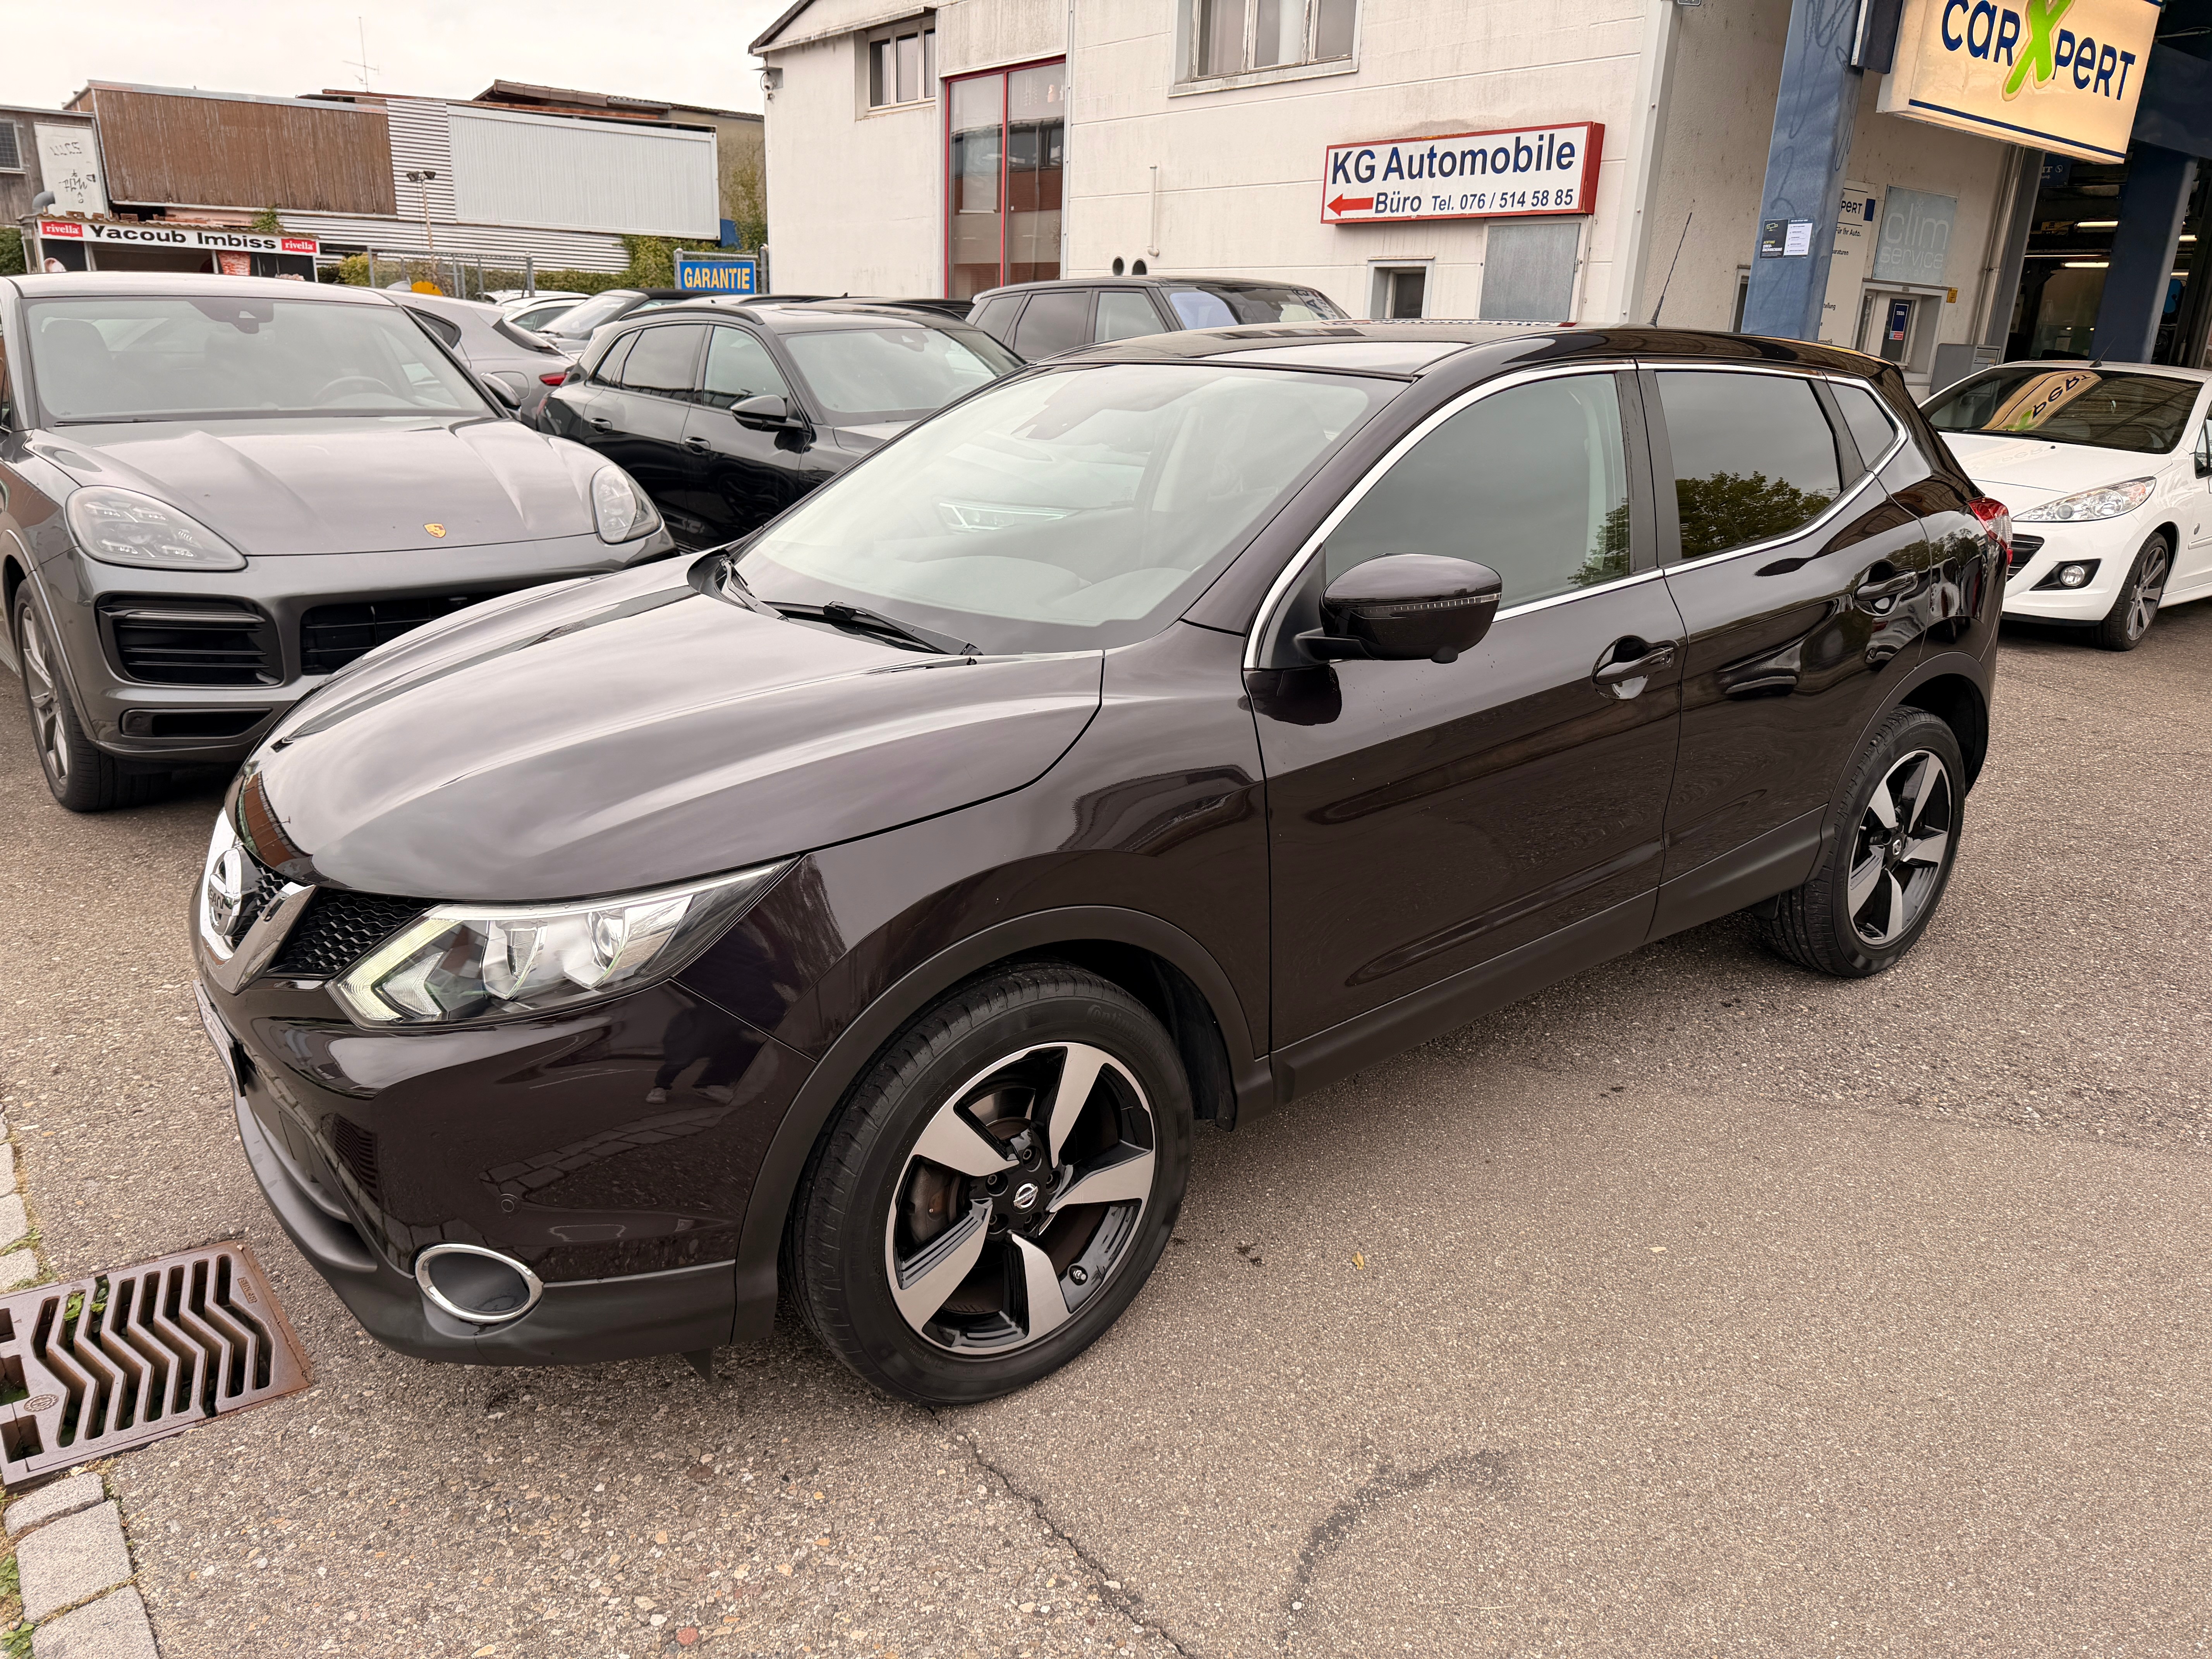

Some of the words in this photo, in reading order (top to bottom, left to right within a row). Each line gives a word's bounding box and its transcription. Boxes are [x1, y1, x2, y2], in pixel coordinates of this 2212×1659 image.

[1332, 149, 1376, 184] KG
[1382, 134, 1575, 181] Automobile
[1375, 191, 1422, 213] Büro
[1432, 195, 1454, 211] Tel.
[1460, 193, 1486, 210] 076
[1499, 191, 1525, 208] 514
[1531, 190, 1549, 207] 58
[1554, 189, 1573, 206] 85
[46, 223, 79, 234] rivella
[89, 225, 186, 243] Yacoub
[197, 232, 276, 249] Imbiss
[1885, 203, 1949, 250] clim
[285, 241, 313, 250] rivella
[1879, 246, 1944, 270] service
[684, 267, 750, 289] GARANTIE
